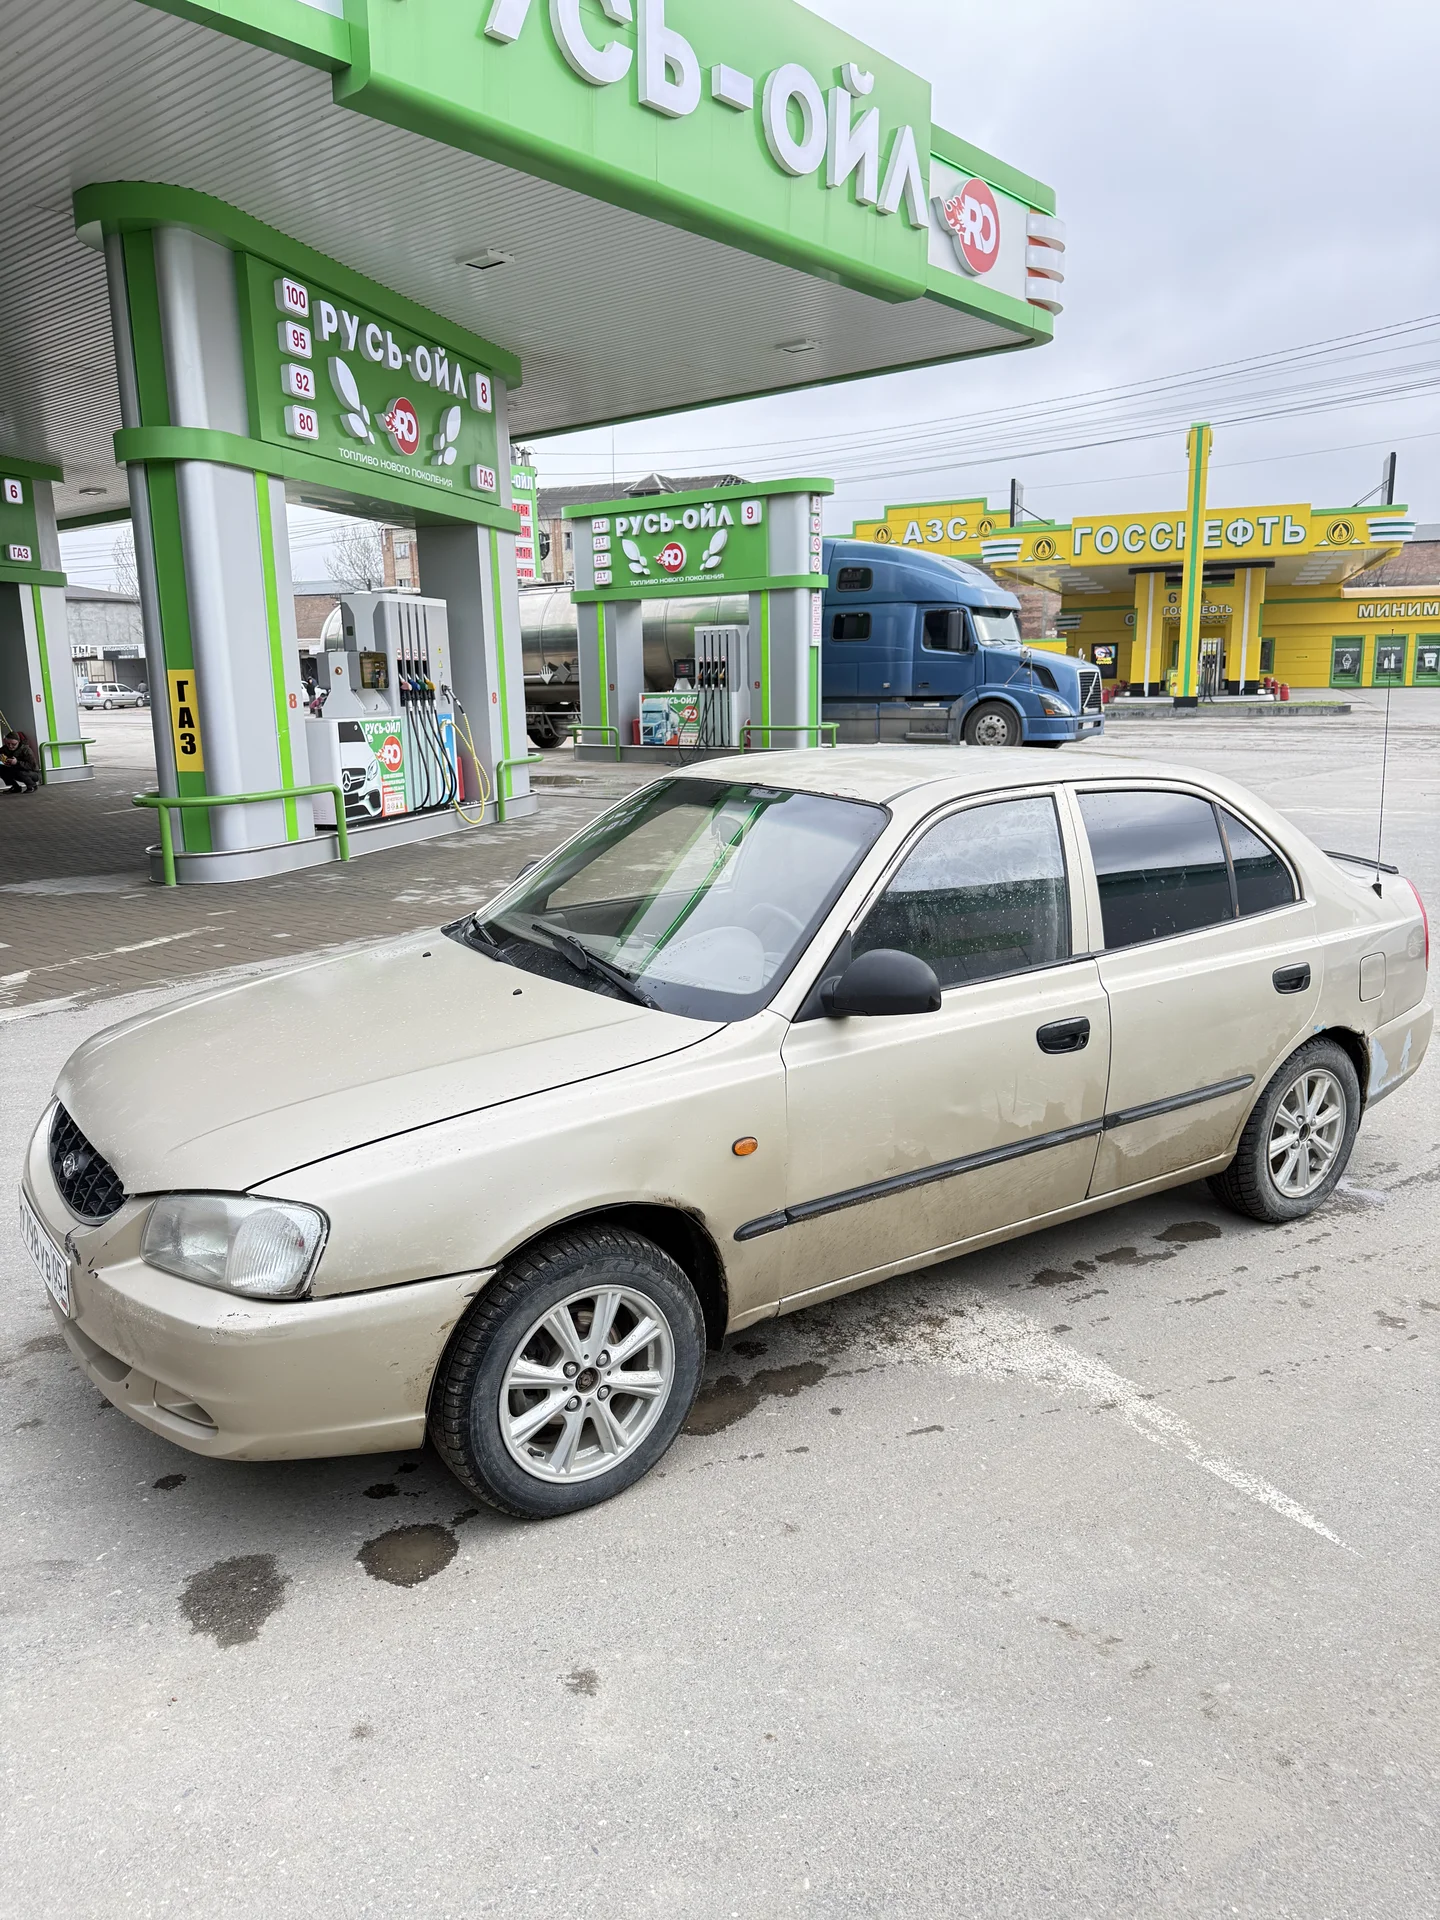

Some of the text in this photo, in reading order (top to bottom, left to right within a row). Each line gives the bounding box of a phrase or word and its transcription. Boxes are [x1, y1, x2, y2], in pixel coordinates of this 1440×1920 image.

[286, 285, 306, 309] 100
[292, 329, 306, 350] 95
[312, 300, 468, 399] РУСЬ-ОЙЛ
[295, 372, 310, 392] 92
[480, 382, 488, 404] 8
[298, 412, 313, 432] 80
[338, 447, 453, 488] ТОПЛИВО НОВОГО ПОКОЛЕНИЯ
[479, 469, 494, 488] ГАЗ
[10, 484, 18, 499] 6
[615, 502, 734, 537] РУСЬ-ОЙЛ
[746, 506, 754, 519] 9
[594, 520, 606, 529] ДТ
[902, 517, 968, 545] АЗС
[595, 537, 606, 545] ДТ
[12, 547, 29, 559] ГАЗ
[629, 573, 725, 586] ТОПЛИВО НОВОГО ПОКОЛЕНИЯ
[1168, 592, 1177, 604] 6
[1357, 601, 1440, 618] МИНИМ
[288, 693, 298, 709] 8
[491, 692, 498, 704] 8
[176, 680, 197, 755] ГАЗ
[364, 719, 401, 735] РУСЬ-ОЙЛ
